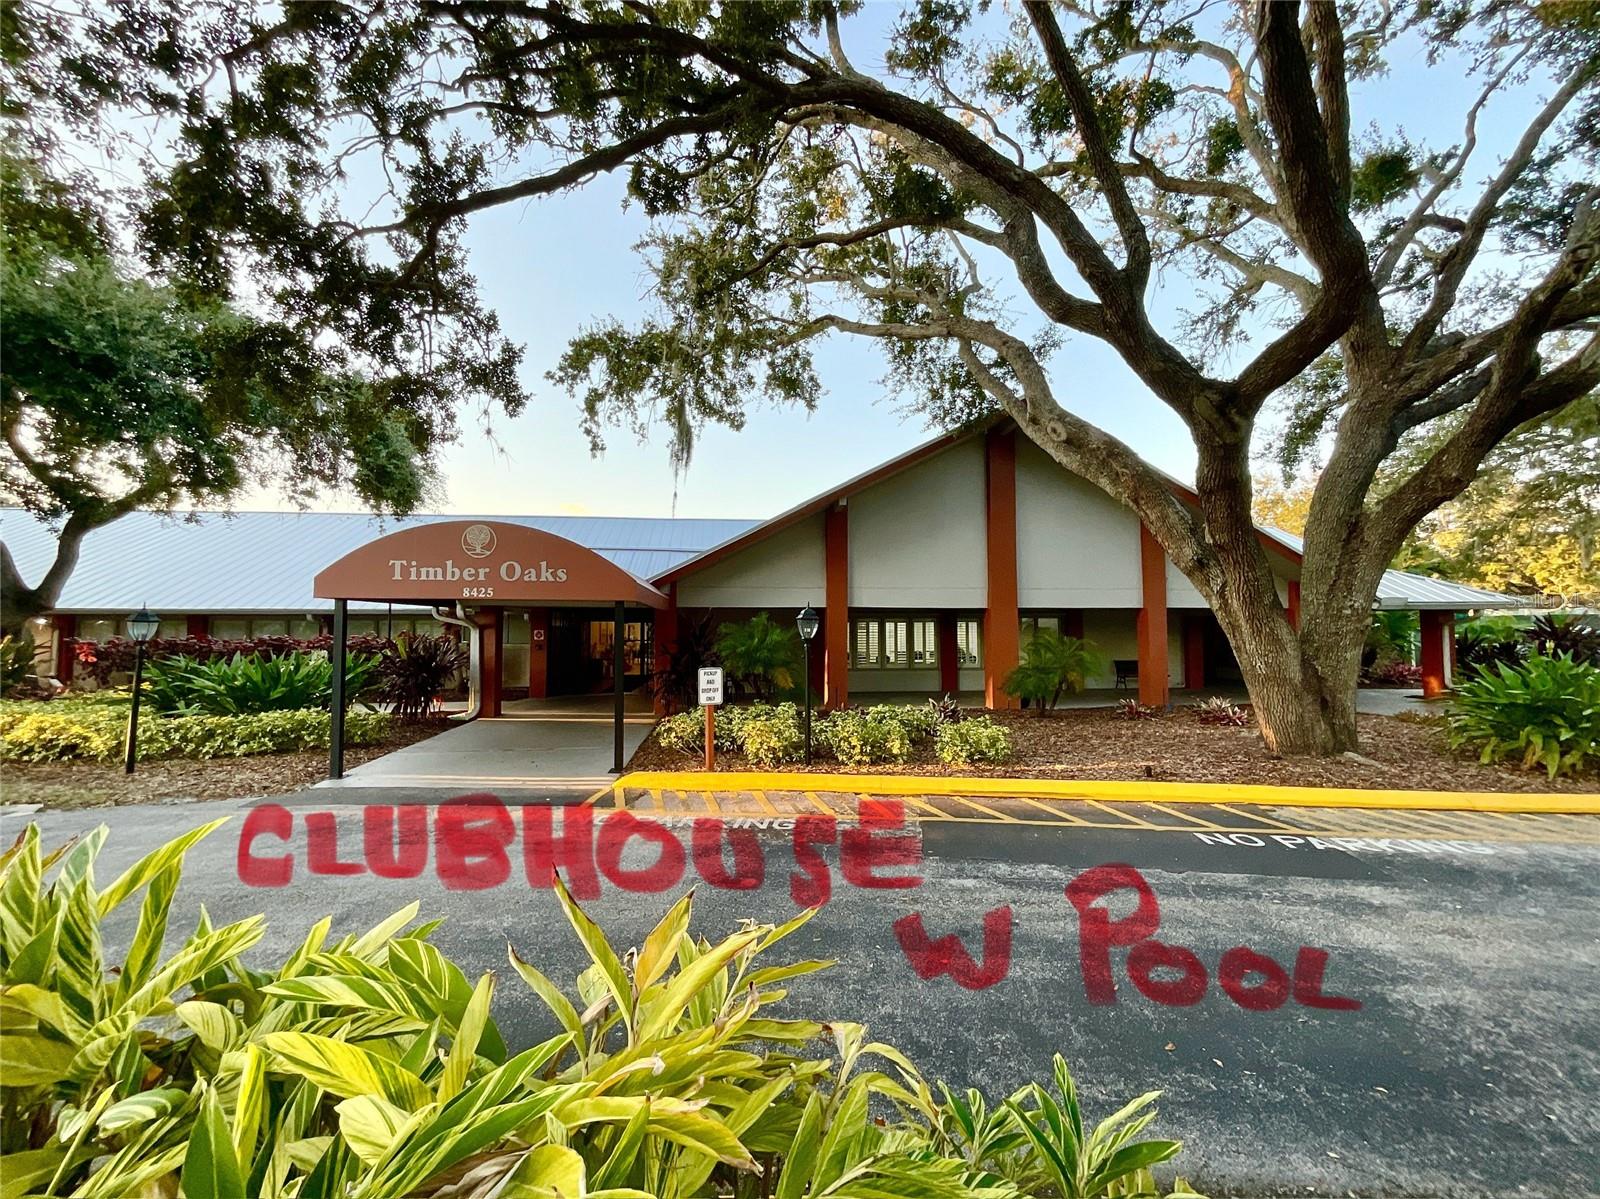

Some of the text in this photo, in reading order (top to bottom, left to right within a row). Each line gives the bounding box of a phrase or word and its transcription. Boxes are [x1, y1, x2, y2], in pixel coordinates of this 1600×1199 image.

[388, 559, 568, 583] Timber Oaks
[462, 587, 494, 598] 8425
[1193, 832, 1496, 854] NO PARKING
